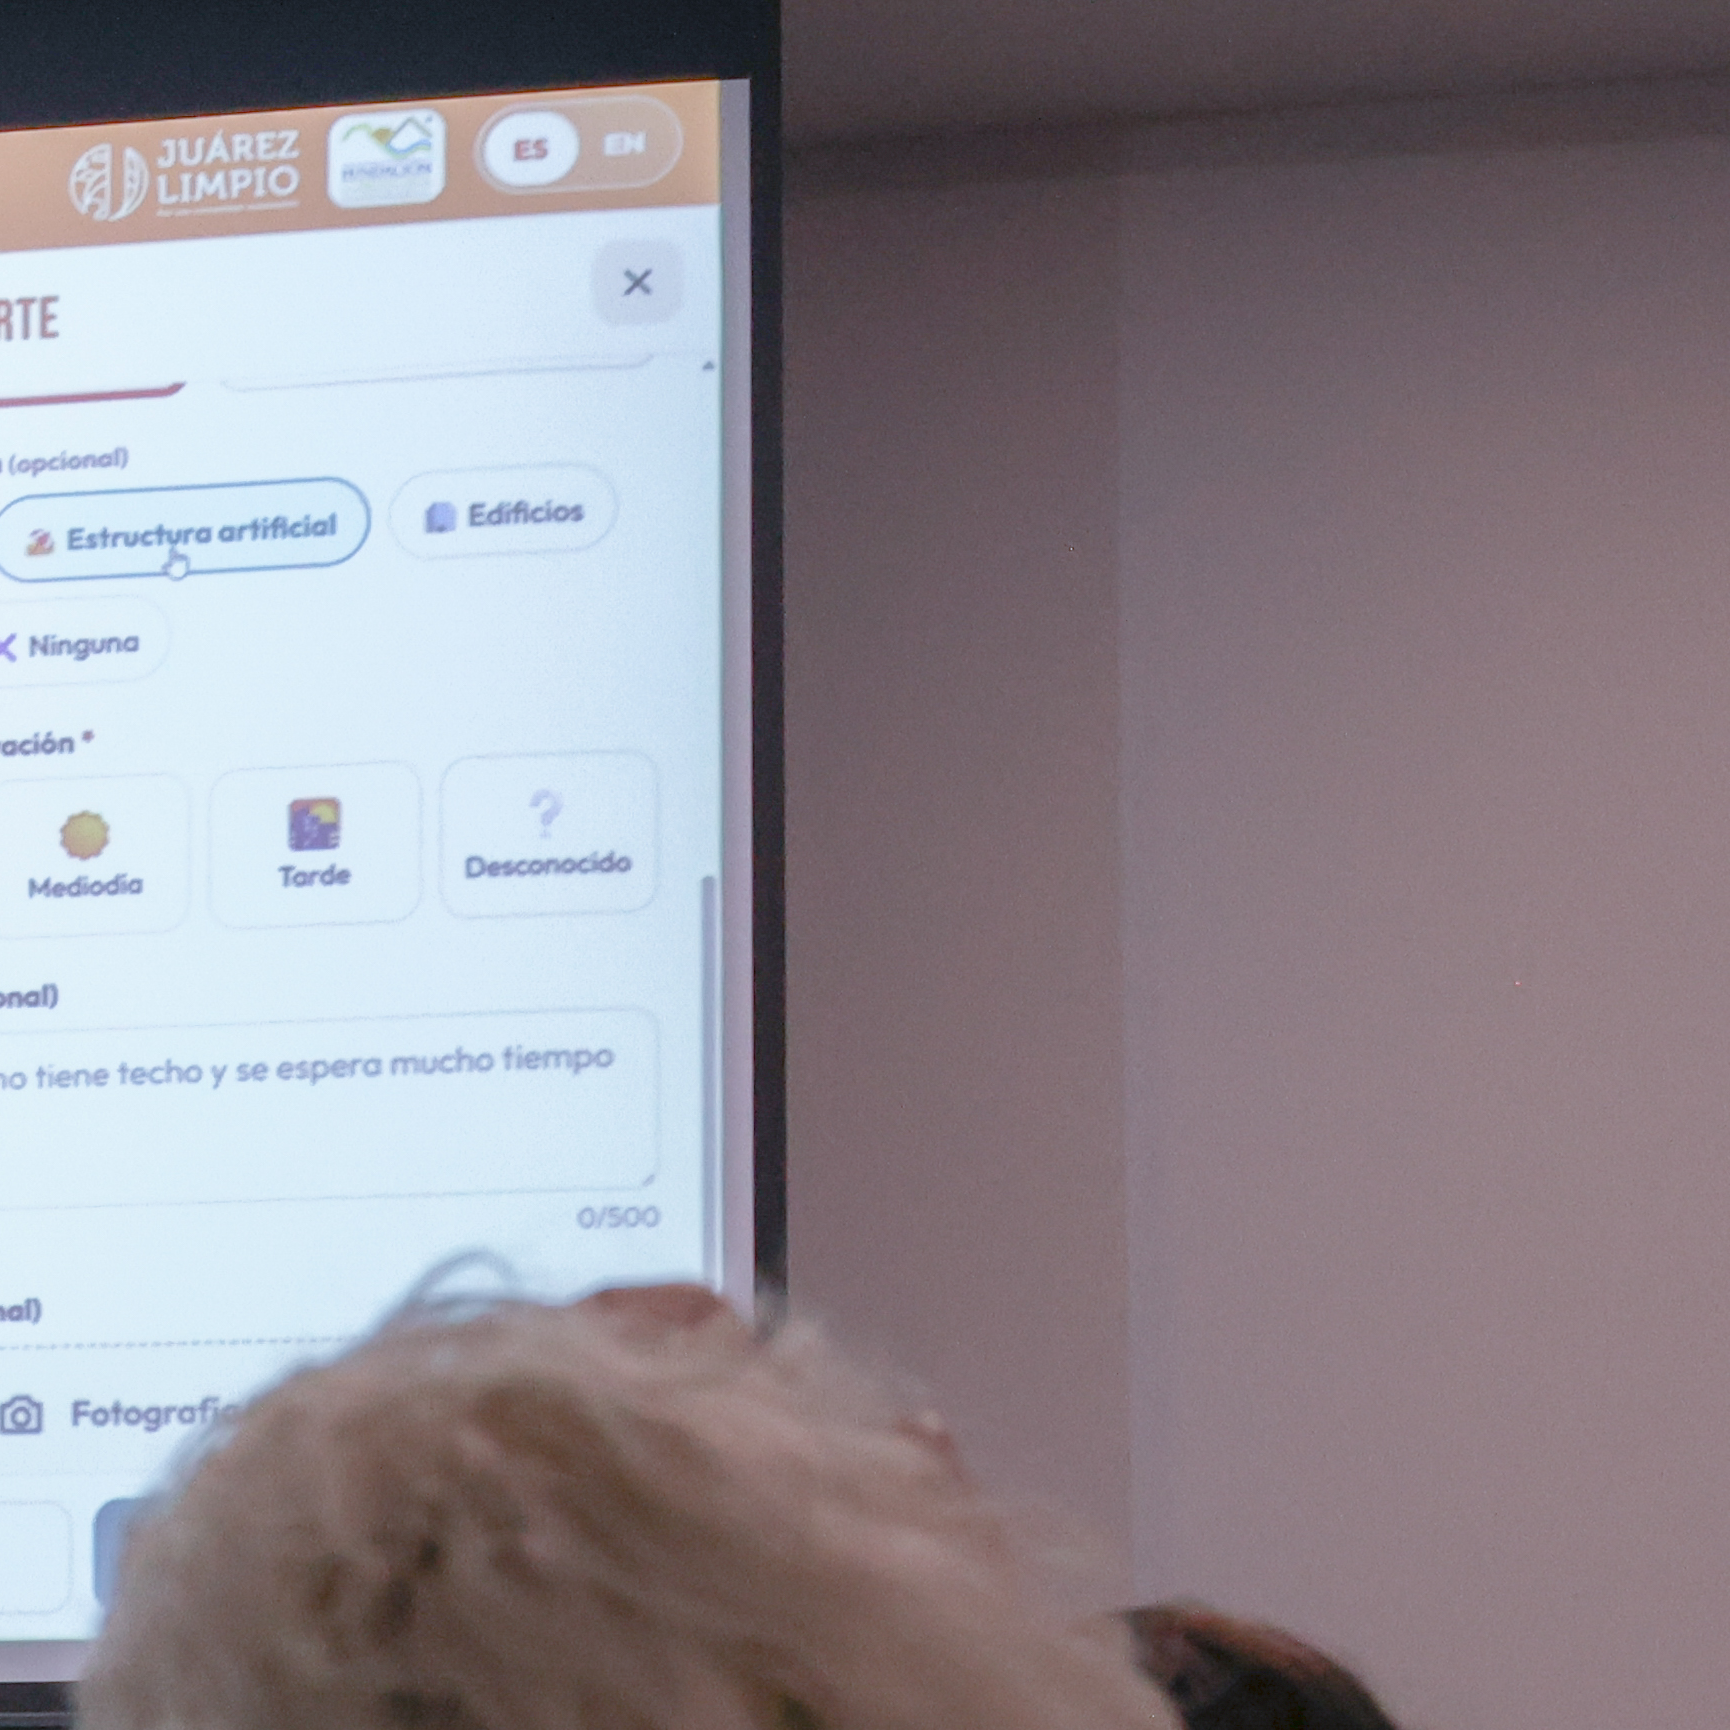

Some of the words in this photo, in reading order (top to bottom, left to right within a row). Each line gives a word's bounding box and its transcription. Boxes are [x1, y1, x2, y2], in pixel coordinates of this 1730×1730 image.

[156, 129, 299, 169] JUÁREZ
[513, 139, 547, 160] ES
[604, 132, 646, 154] EN
[157, 164, 299, 204] LIMPIO
[8, 447, 129, 479] (opcional)
[469, 500, 584, 527] Edificios
[67, 521, 213, 551] Estructura
[218, 512, 337, 542] artificial
[28, 634, 140, 660] Ninguna
[279, 863, 351, 888] Tarde
[465, 851, 632, 879] Desconocido
[36, 1064, 109, 1089] tiene
[117, 1059, 203, 1086] techo
[212, 1064, 227, 1088] y
[236, 1063, 269, 1082] se
[277, 1057, 382, 1085] espera
[390, 1047, 494, 1076] mucho
[502, 1044, 615, 1076] tiempo
[577, 1206, 660, 1230] 0/500
